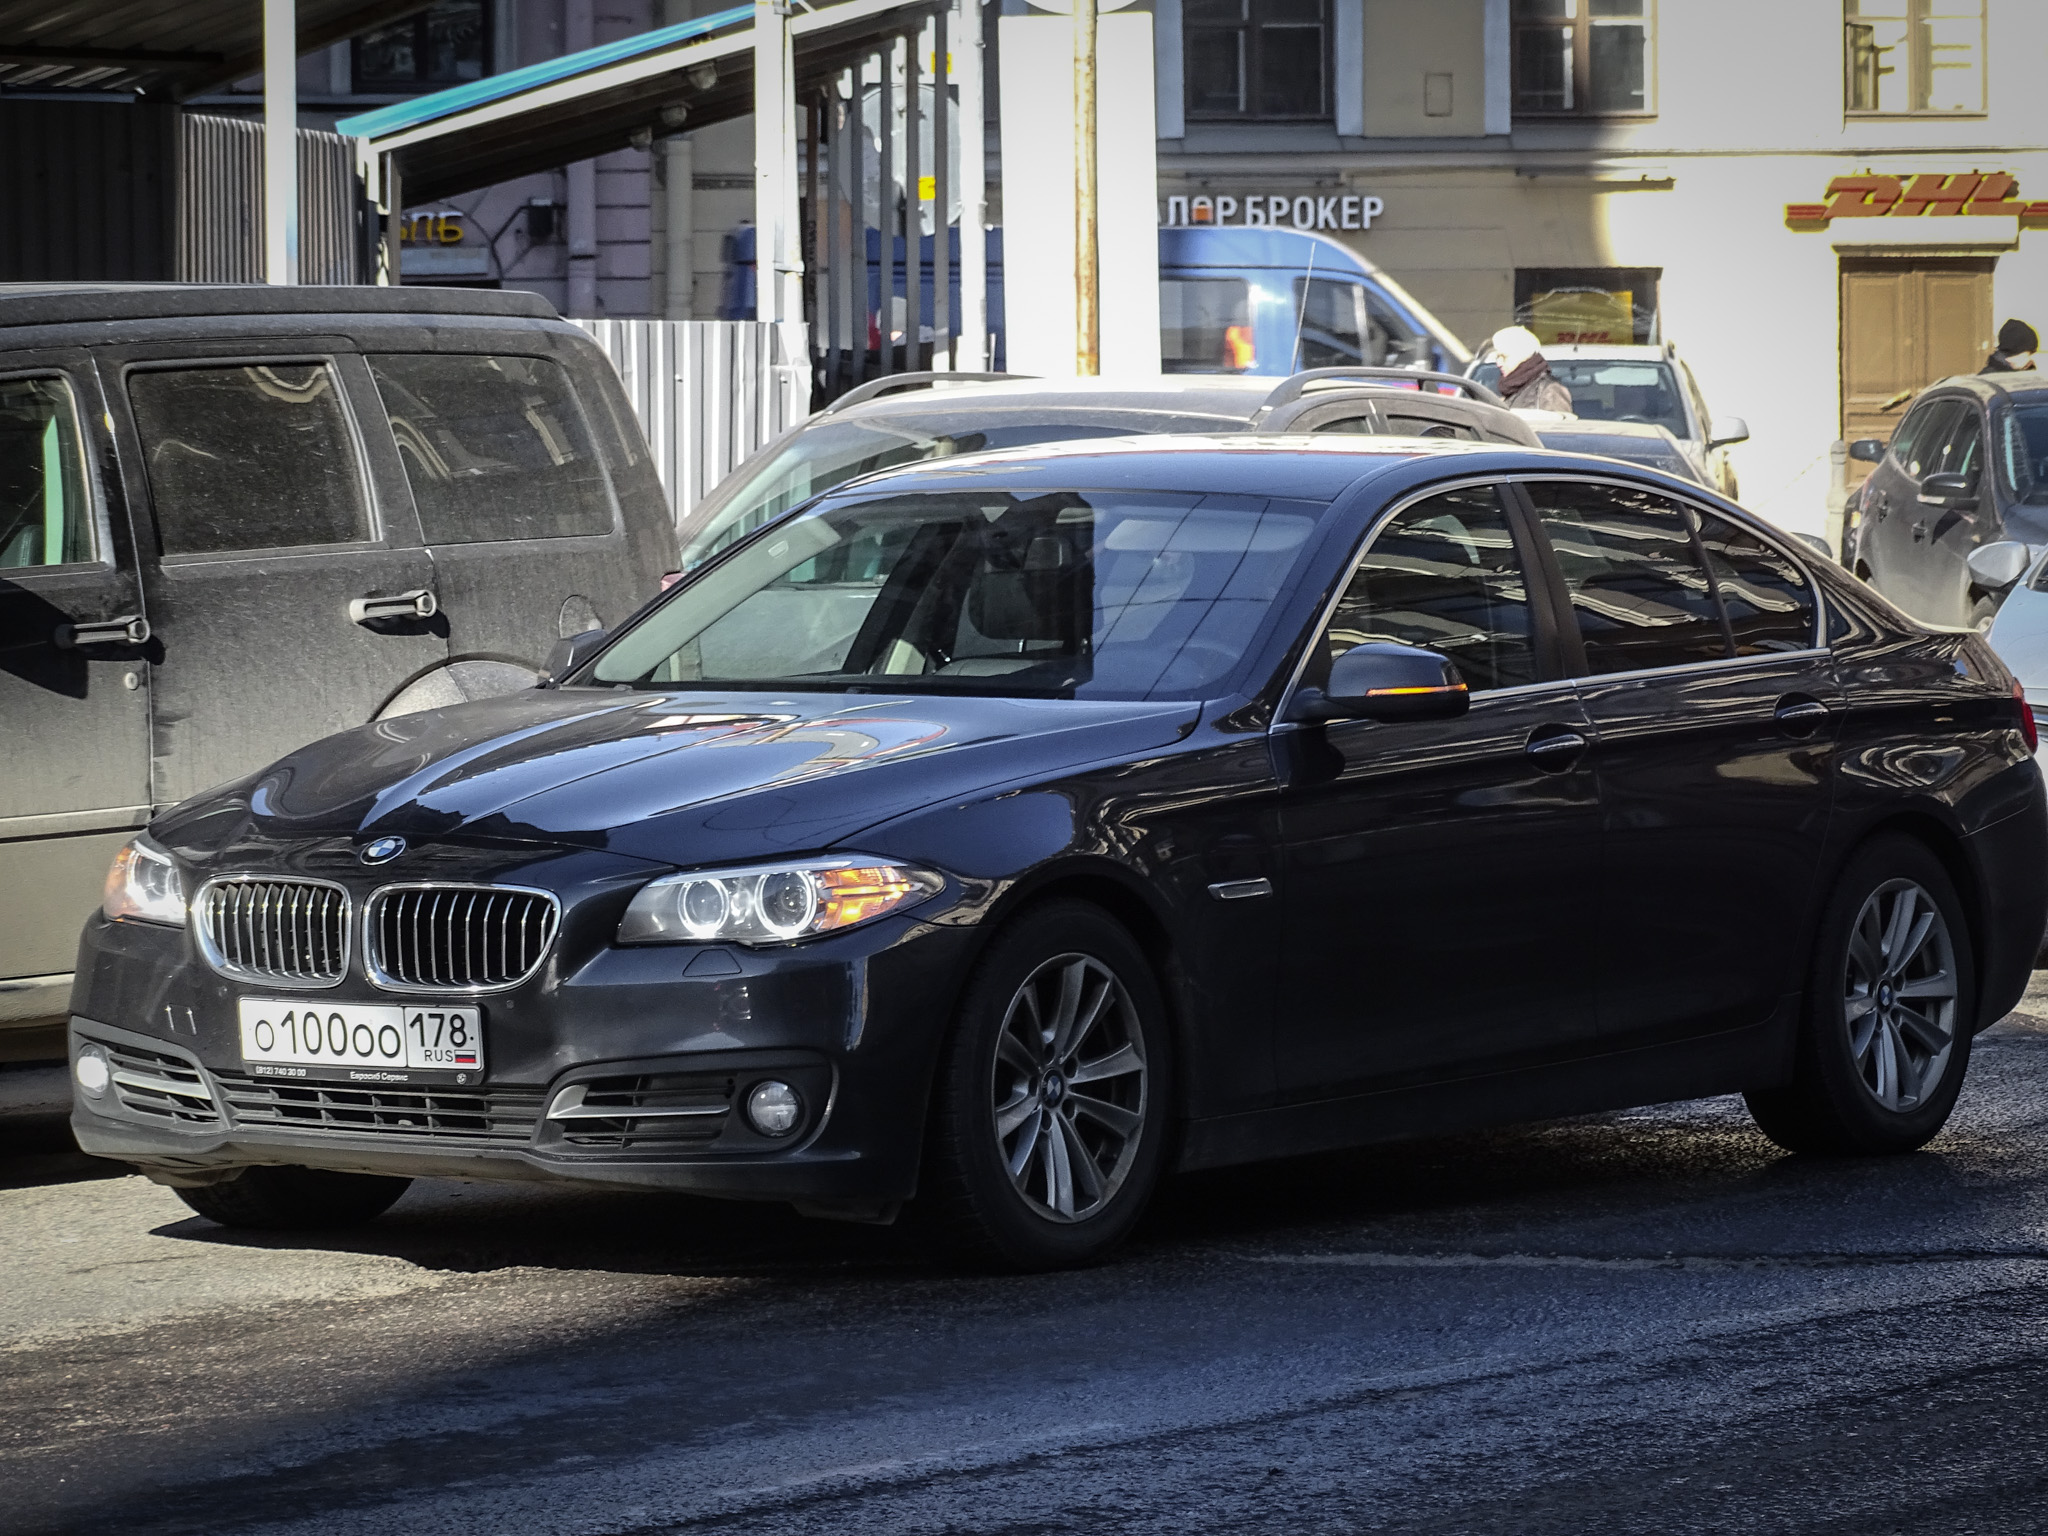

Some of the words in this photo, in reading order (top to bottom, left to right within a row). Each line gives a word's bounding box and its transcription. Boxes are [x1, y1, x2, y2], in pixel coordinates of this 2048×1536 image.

[1244, 195, 1384, 230] БРОКЕР
[1822, 174, 2028, 219] DHL
[409, 1012, 467, 1048] 178
[424, 1050, 454, 1062] RUS
